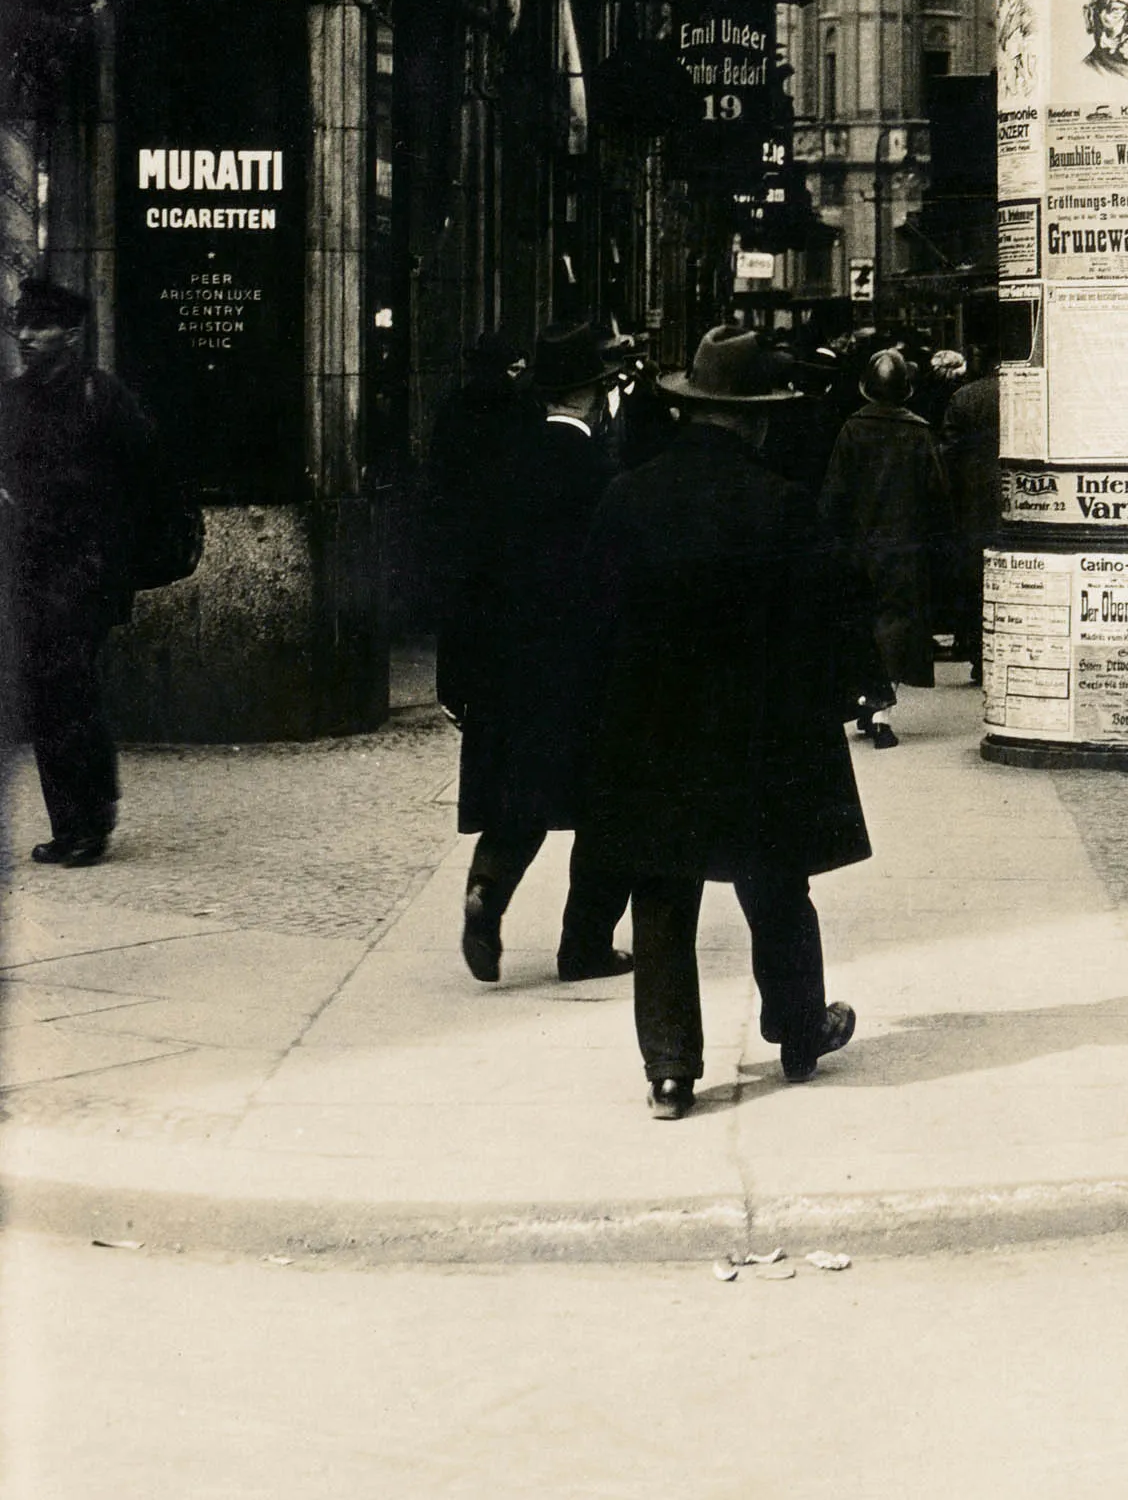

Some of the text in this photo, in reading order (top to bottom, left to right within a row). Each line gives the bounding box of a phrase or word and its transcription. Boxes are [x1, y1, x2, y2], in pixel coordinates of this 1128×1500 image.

[679, 17, 768, 52] Emil Unger
[676, 55, 769, 86] ntor-Bedarf
[702, 93, 743, 122] 19
[1049, 144, 1102, 169] Baumblüte
[138, 148, 283, 192] MURATTI
[146, 207, 277, 230] CIGARETTEN
[190, 273, 230, 285] PEER
[160, 288, 263, 302] ARISTON LUXE
[178, 304, 245, 318] GENTRY
[177, 320, 245, 334] ARISTON
[1015, 476, 1059, 493] SCALA
[1010, 556, 1045, 571] heute
[1080, 590, 1099, 622] Der
